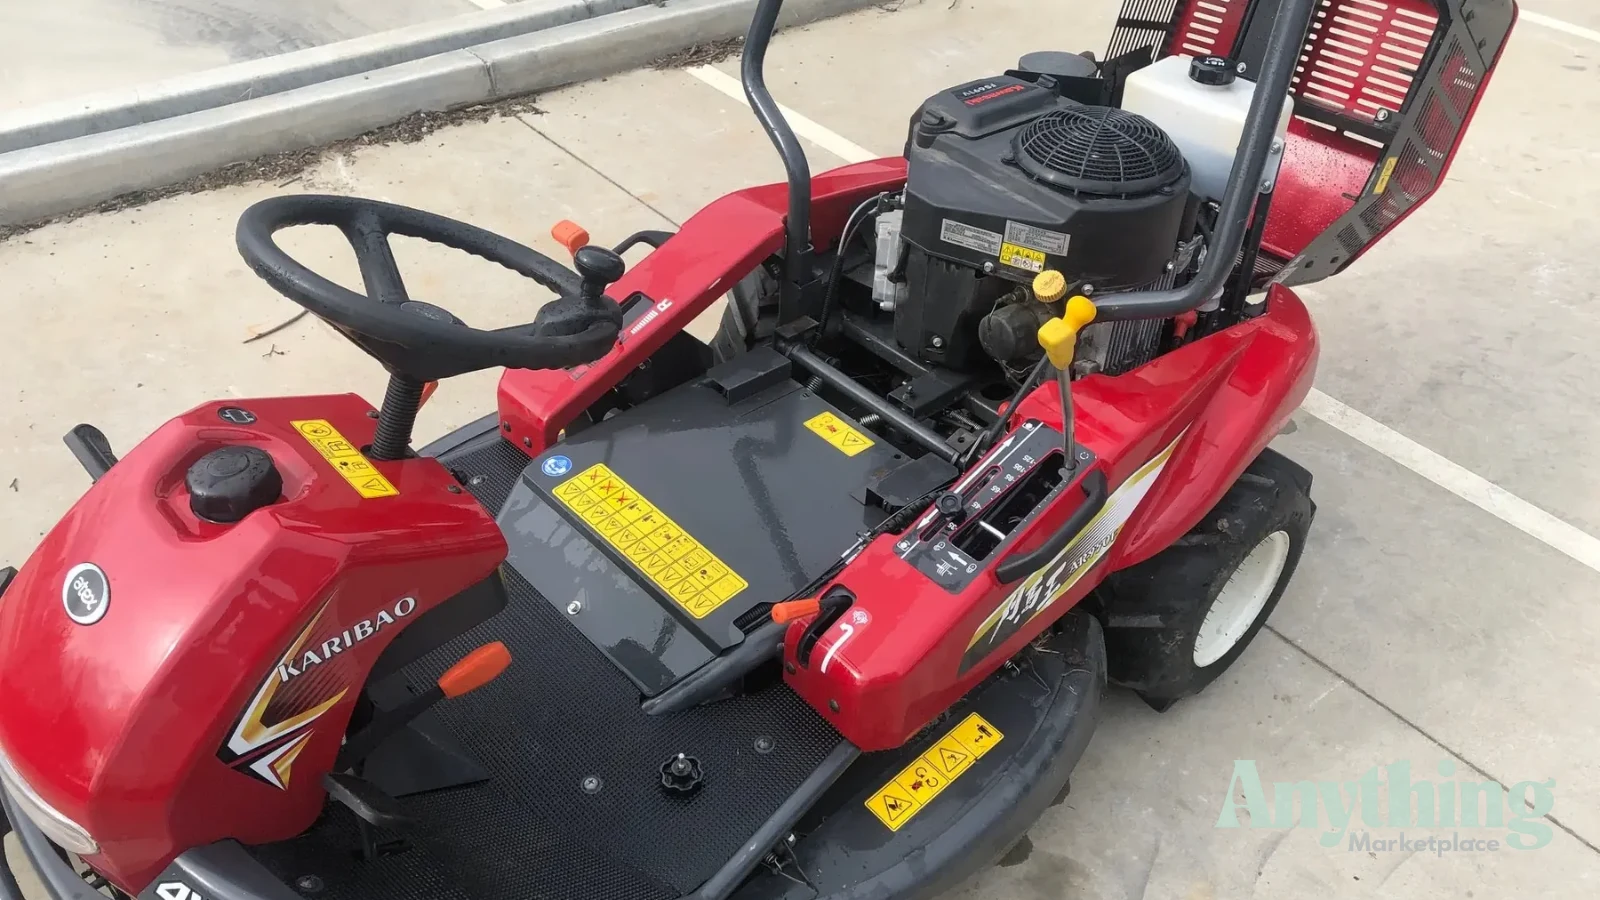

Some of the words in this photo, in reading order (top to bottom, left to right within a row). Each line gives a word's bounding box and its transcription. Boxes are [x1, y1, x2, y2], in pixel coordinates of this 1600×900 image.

[656, 298, 673, 312] R
[73, 576, 97, 611] atex
[277, 596, 416, 682] KARIBAO
